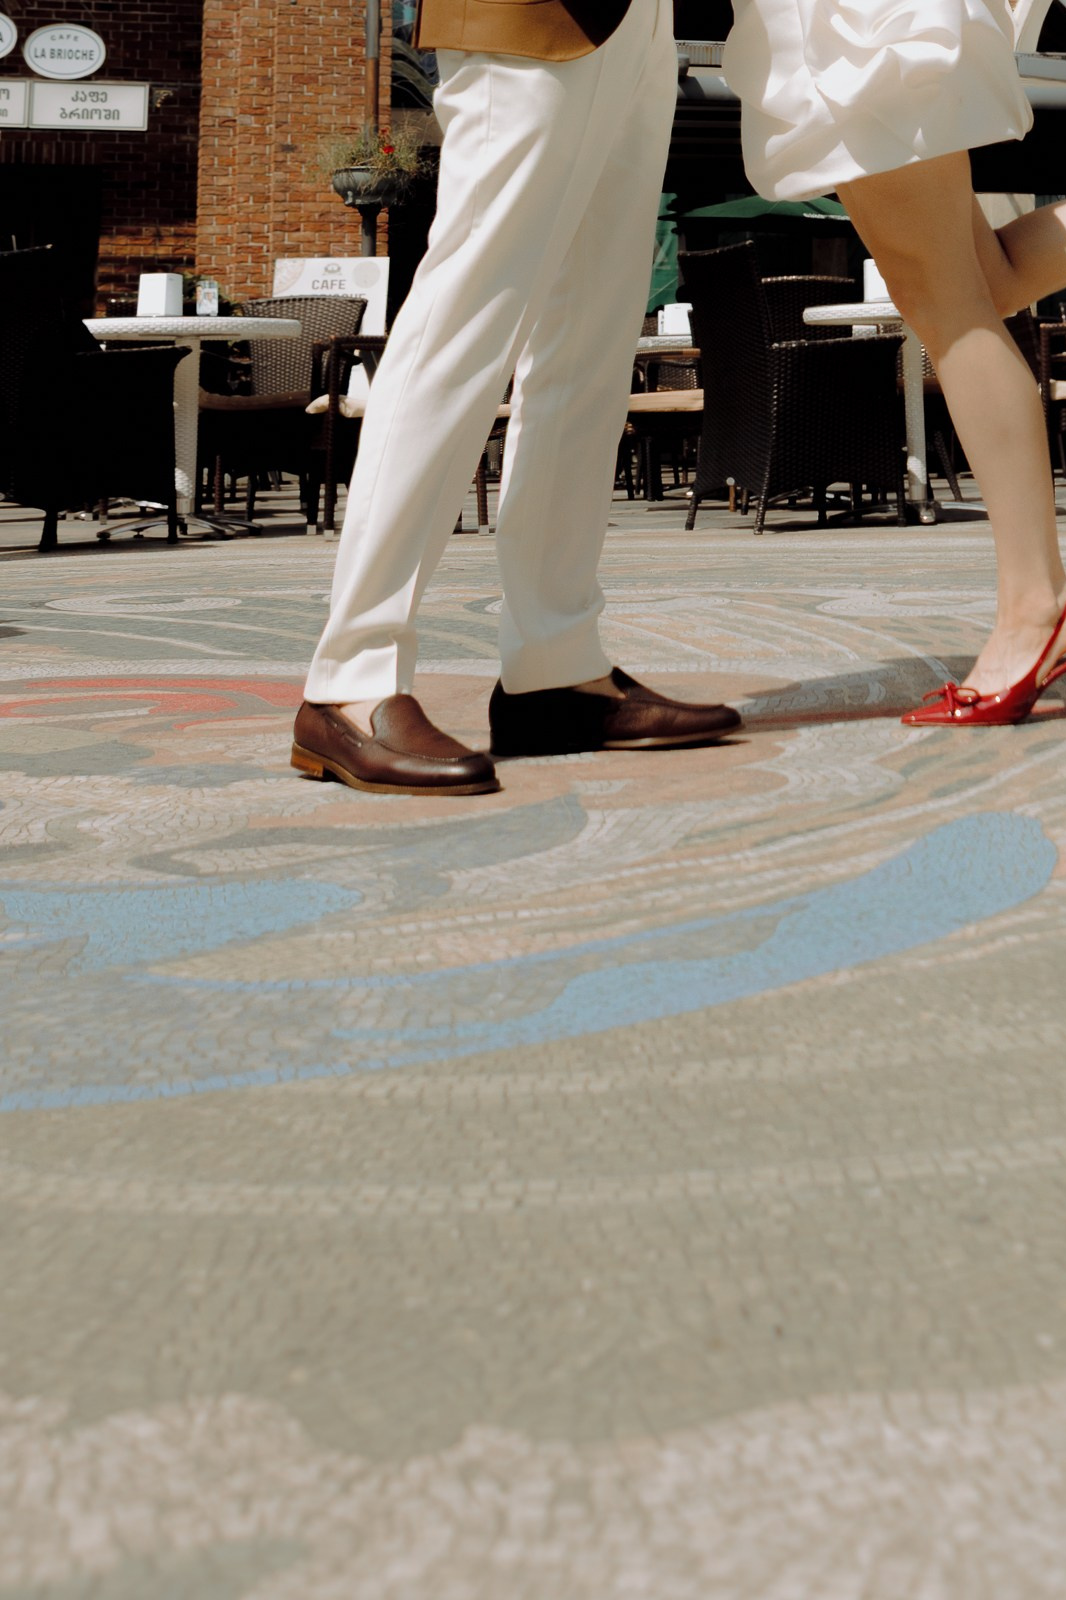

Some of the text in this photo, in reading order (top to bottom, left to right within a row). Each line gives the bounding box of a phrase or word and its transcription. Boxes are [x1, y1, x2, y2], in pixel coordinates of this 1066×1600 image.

[50, 34, 80, 42] CAFE
[34, 48, 95, 61] LA BRIOCHE
[71, 90, 108, 103] კაფე
[59, 107, 120, 121] ბრიოში
[311, 279, 346, 290] CAFE
